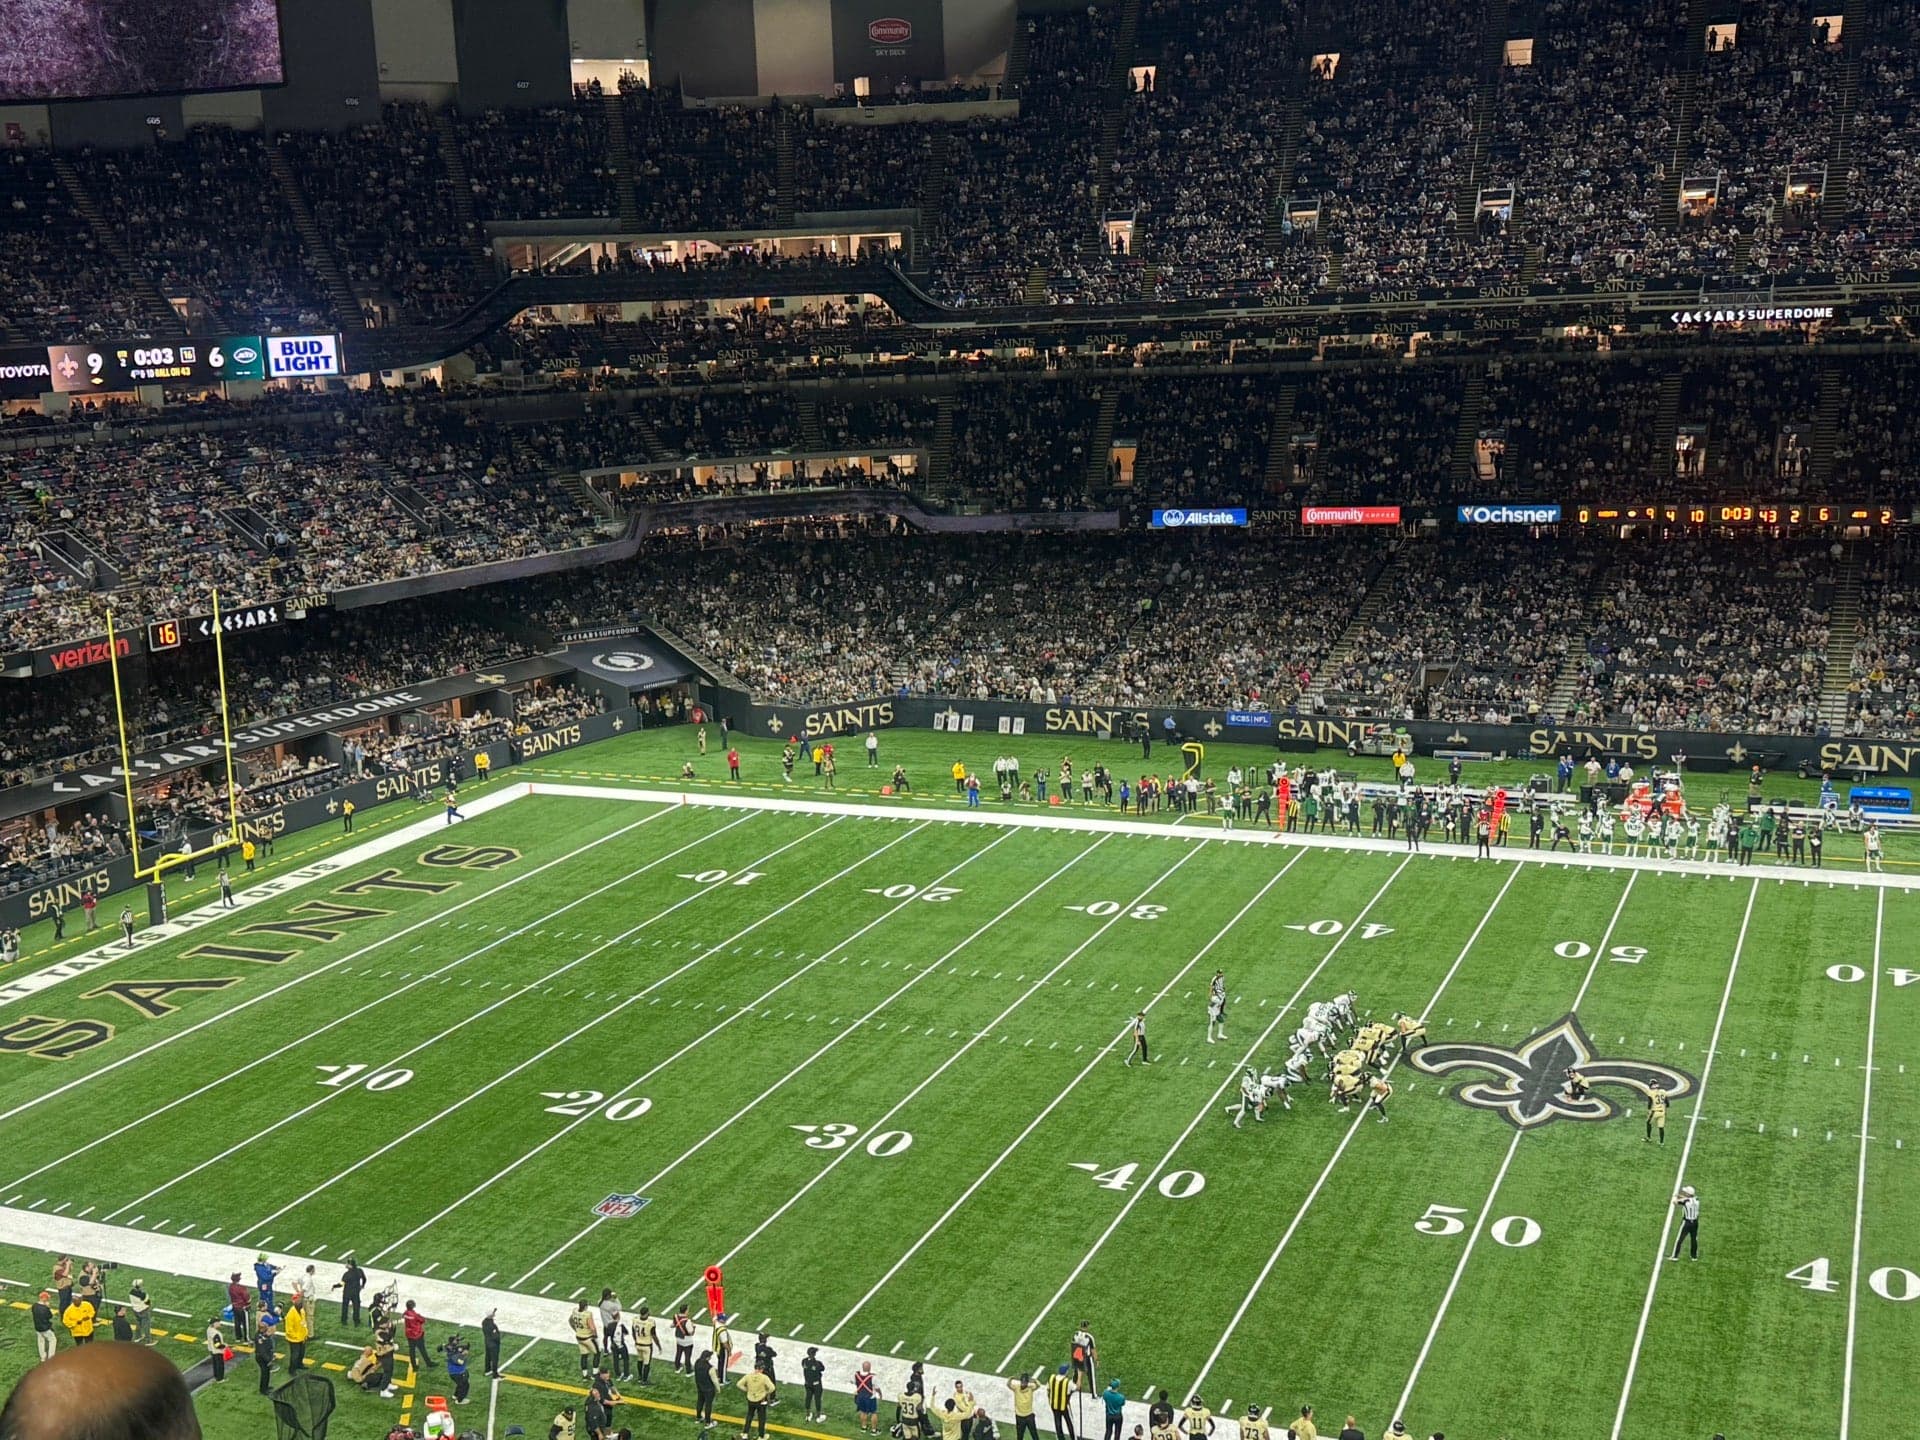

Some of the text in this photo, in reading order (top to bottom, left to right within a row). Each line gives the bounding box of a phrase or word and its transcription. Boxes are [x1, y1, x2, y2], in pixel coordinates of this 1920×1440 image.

[872, 26, 909, 37] Community
[1834, 271, 1891, 284] SAINTS
[1479, 286, 1529, 298] SAINTS
[1594, 281, 1646, 293] SAINTS
[1262, 295, 1310, 307] SAINTS
[1369, 290, 1419, 303] SAINTS
[1578, 314, 1627, 326] SAINTS
[1671, 307, 1833, 325] CAESARS SUPERDOME
[1373, 321, 1419, 334] SAINTS
[1473, 318, 1520, 331] SAINTS
[1180, 329, 1223, 341] SAINTS
[1275, 326, 1319, 337] SAINTS
[994, 337, 1036, 349] SAINTS
[1086, 333, 1128, 345] SAINTS
[281, 341, 323, 356] BUD
[809, 344, 852, 355] SAINTS
[901, 340, 943, 352] SAINTS
[134, 347, 174, 366] 0:03
[208, 346, 225, 367] 6
[629, 352, 669, 365] SAINTS
[717, 349, 759, 361] SAINTS
[87, 353, 103, 375] 9
[274, 355, 332, 371] LIGHT
[541, 357, 581, 370] SAINTS
[0, 364, 50, 378] TOYOTA
[1252, 510, 1296, 521] SAINTS
[1306, 508, 1363, 522] Community
[1473, 507, 1557, 523] Ochsner
[1579, 511, 1588, 523] 0
[1646, 508, 1655, 520] 9
[1666, 511, 1675, 522] 4
[1691, 510, 1704, 523] 10
[1721, 507, 1752, 520] 0:03
[1759, 510, 1777, 523] 43
[1790, 510, 1800, 523] 2
[1819, 508, 1828, 521] 6
[1881, 511, 1891, 524] 2
[285, 594, 327, 611] SAINTS
[200, 607, 278, 637] CAESARS
[158, 623, 176, 644] 16
[50, 637, 130, 671] verizon
[805, 702, 894, 737] SAINTS
[1253, 716, 1269, 724] NFL
[1278, 719, 1390, 744] SAINT
[53, 691, 423, 793] CAESARS SUPERDOME
[522, 725, 581, 757] SAINTS
[376, 764, 442, 800] SAINTS
[29, 868, 111, 918] SAINTS
[36, 932, 168, 977] TAKES
[170, 902, 246, 928] ALL
[241, 882, 287, 898] OF
[287, 864, 343, 878] US
[0, 843, 525, 1061] SAINTS
[598, 1202, 633, 1215] NFL
[901, 1401, 914, 1415] 33
[1192, 1417, 1203, 1430] 11
